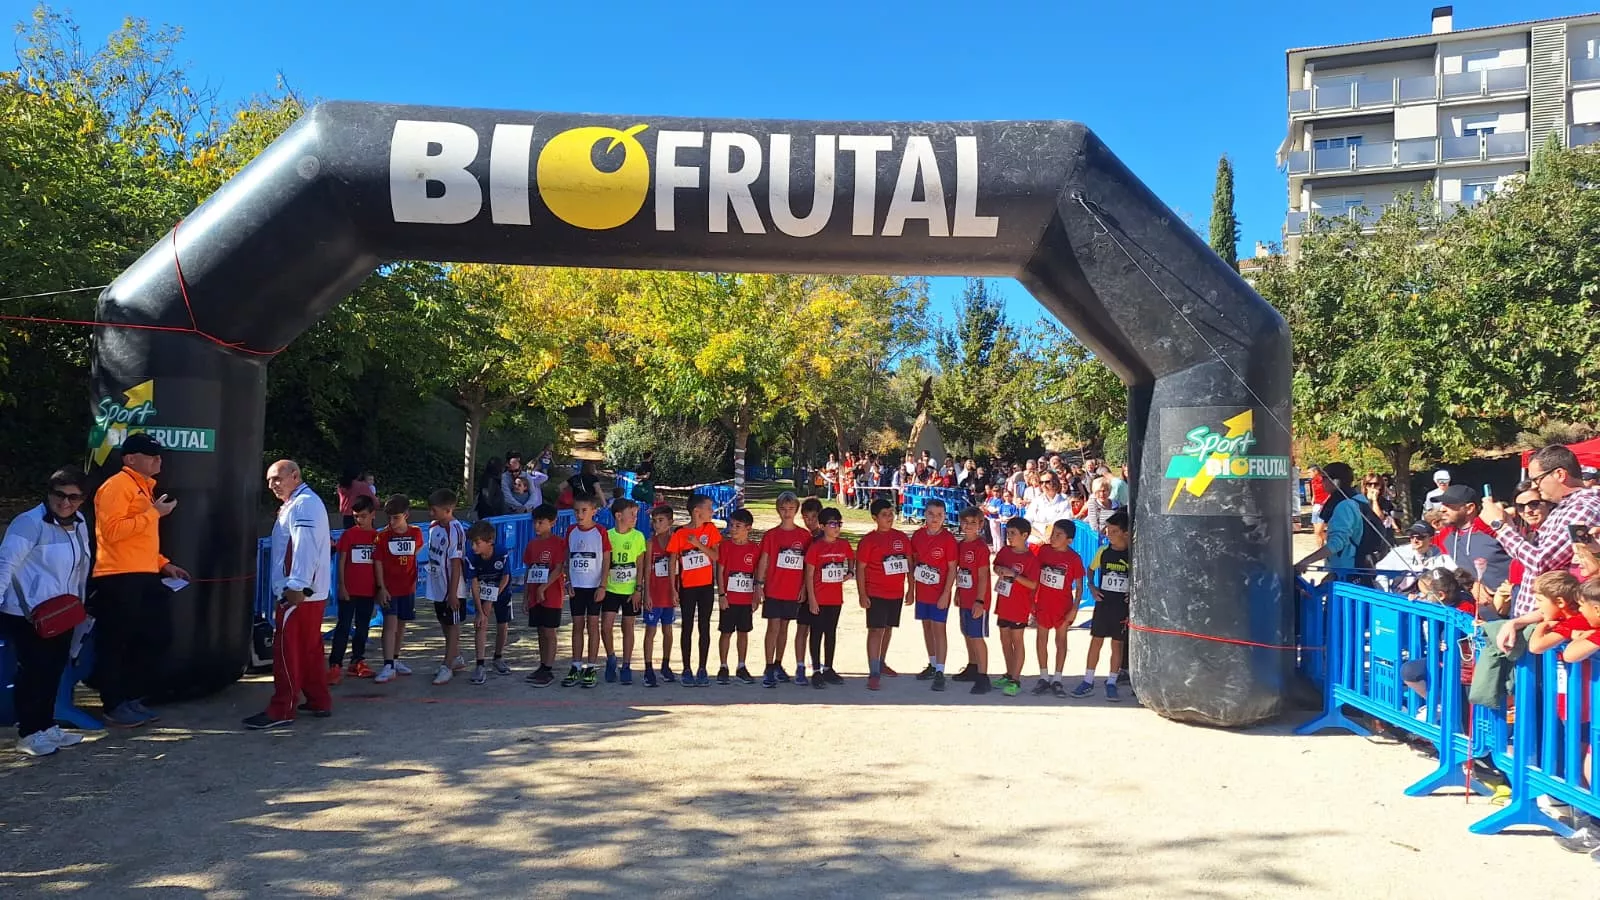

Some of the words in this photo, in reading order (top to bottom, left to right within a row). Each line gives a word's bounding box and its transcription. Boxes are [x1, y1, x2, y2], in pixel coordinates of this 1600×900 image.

[389, 118, 1000, 239] BIOFRUTAL
[95, 398, 156, 430] Sport
[106, 428, 209, 449] BIFRUTAL
[1183, 427, 1254, 462] Sport
[1205, 457, 1288, 477] BIOFRUTAL
[397, 541, 412, 552] 301
[573, 560, 589, 568] 056
[616, 570, 631, 580] 234
[828, 570, 842, 578] 019
[920, 570, 936, 582] 092
[1108, 577, 1125, 587] 017
